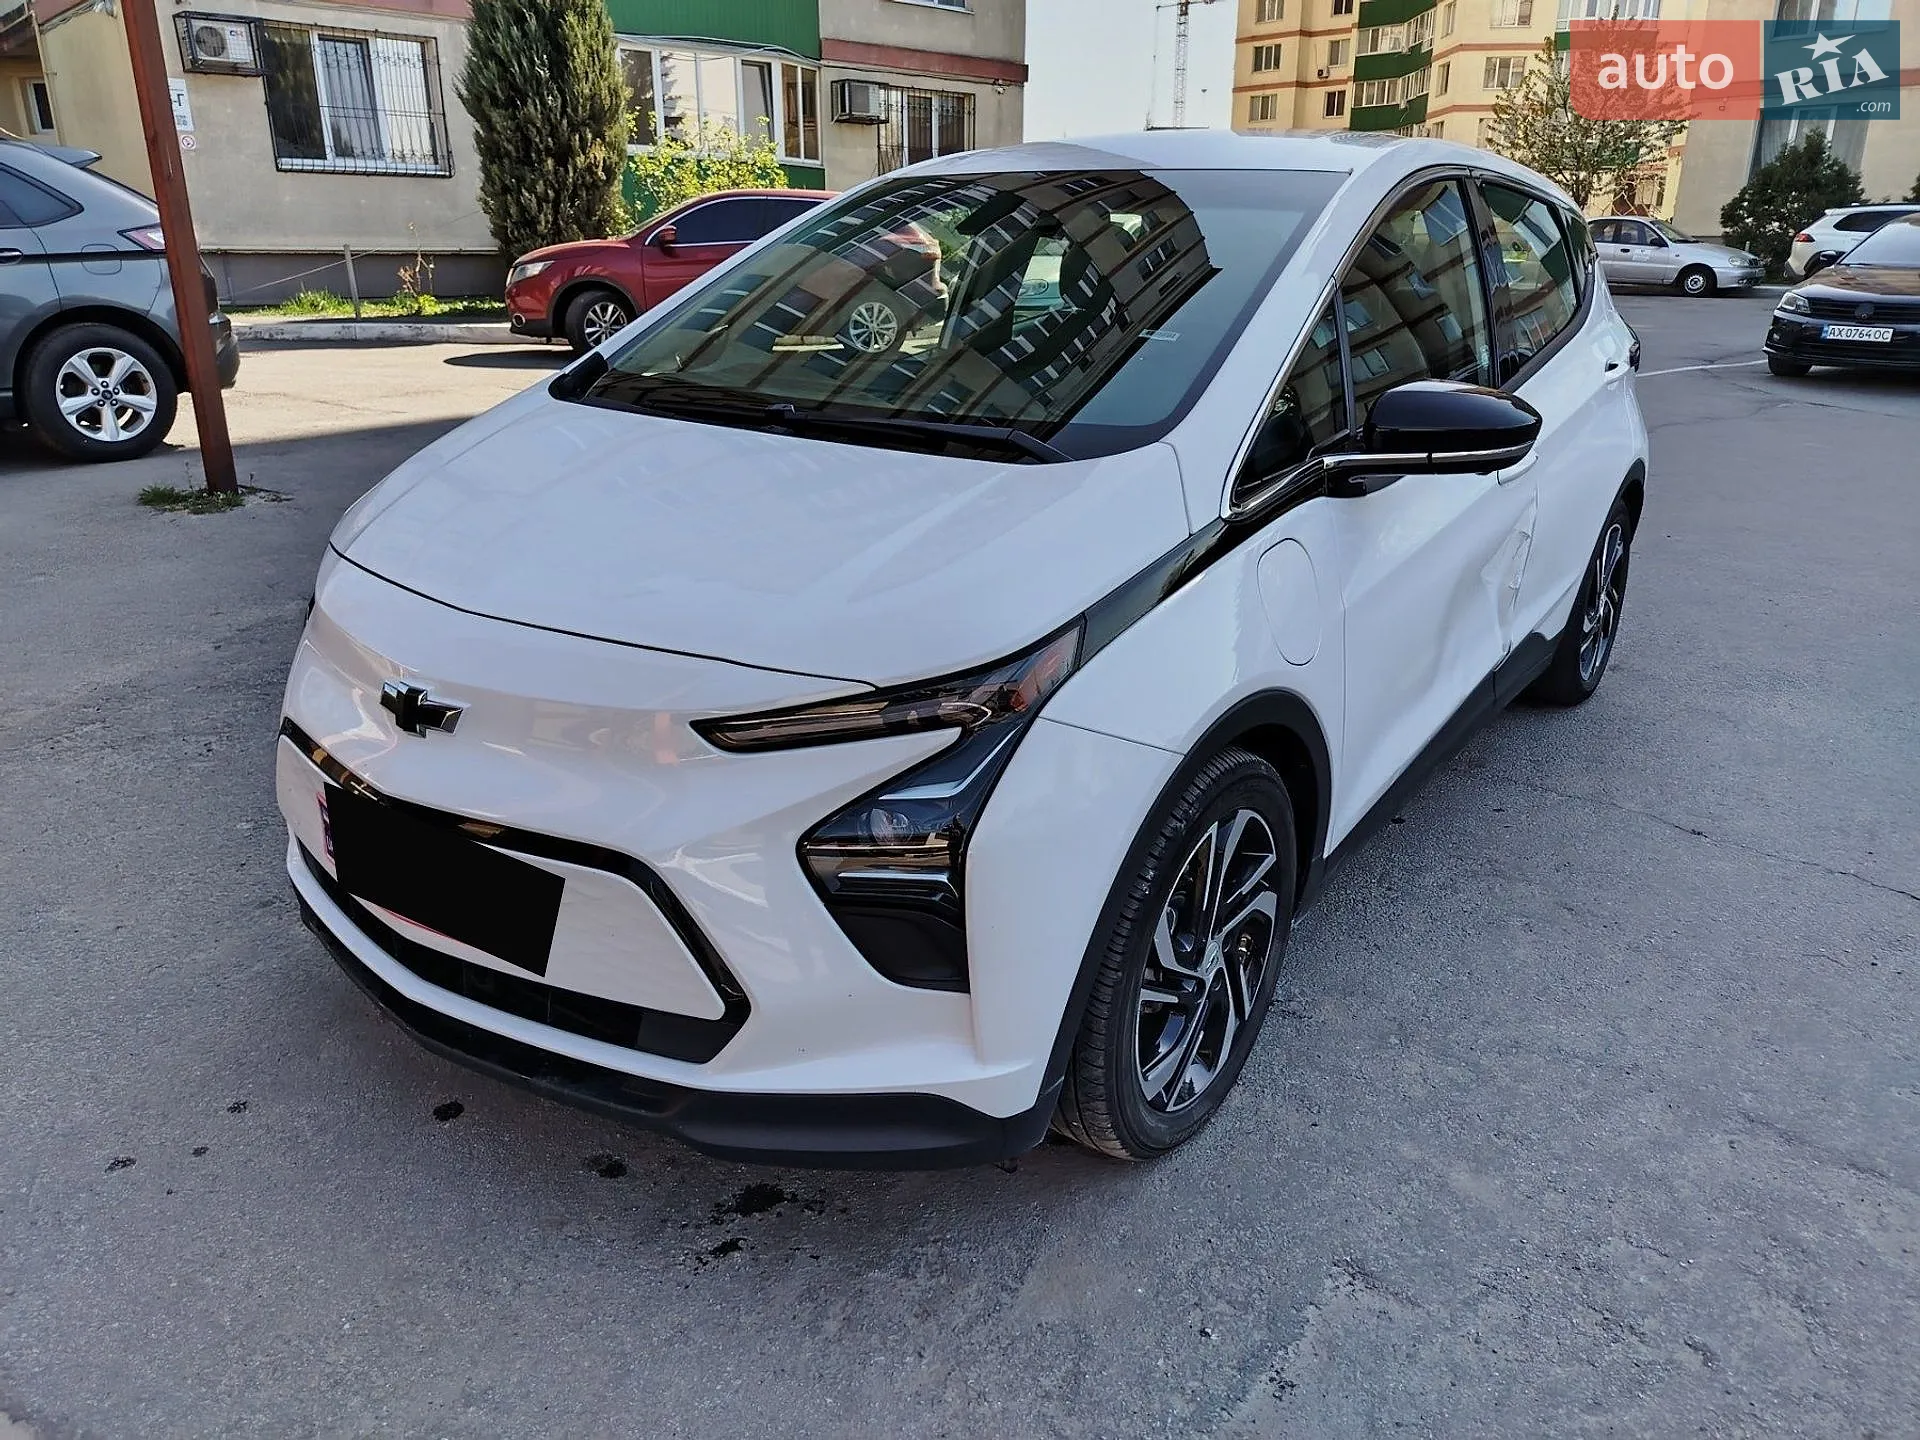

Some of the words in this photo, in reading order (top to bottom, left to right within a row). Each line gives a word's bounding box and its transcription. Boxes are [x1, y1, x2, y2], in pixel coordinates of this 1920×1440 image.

[1829, 327, 1845, 338] AX
[1845, 328, 1872, 339] 0764
[1874, 330, 1890, 340] OC
